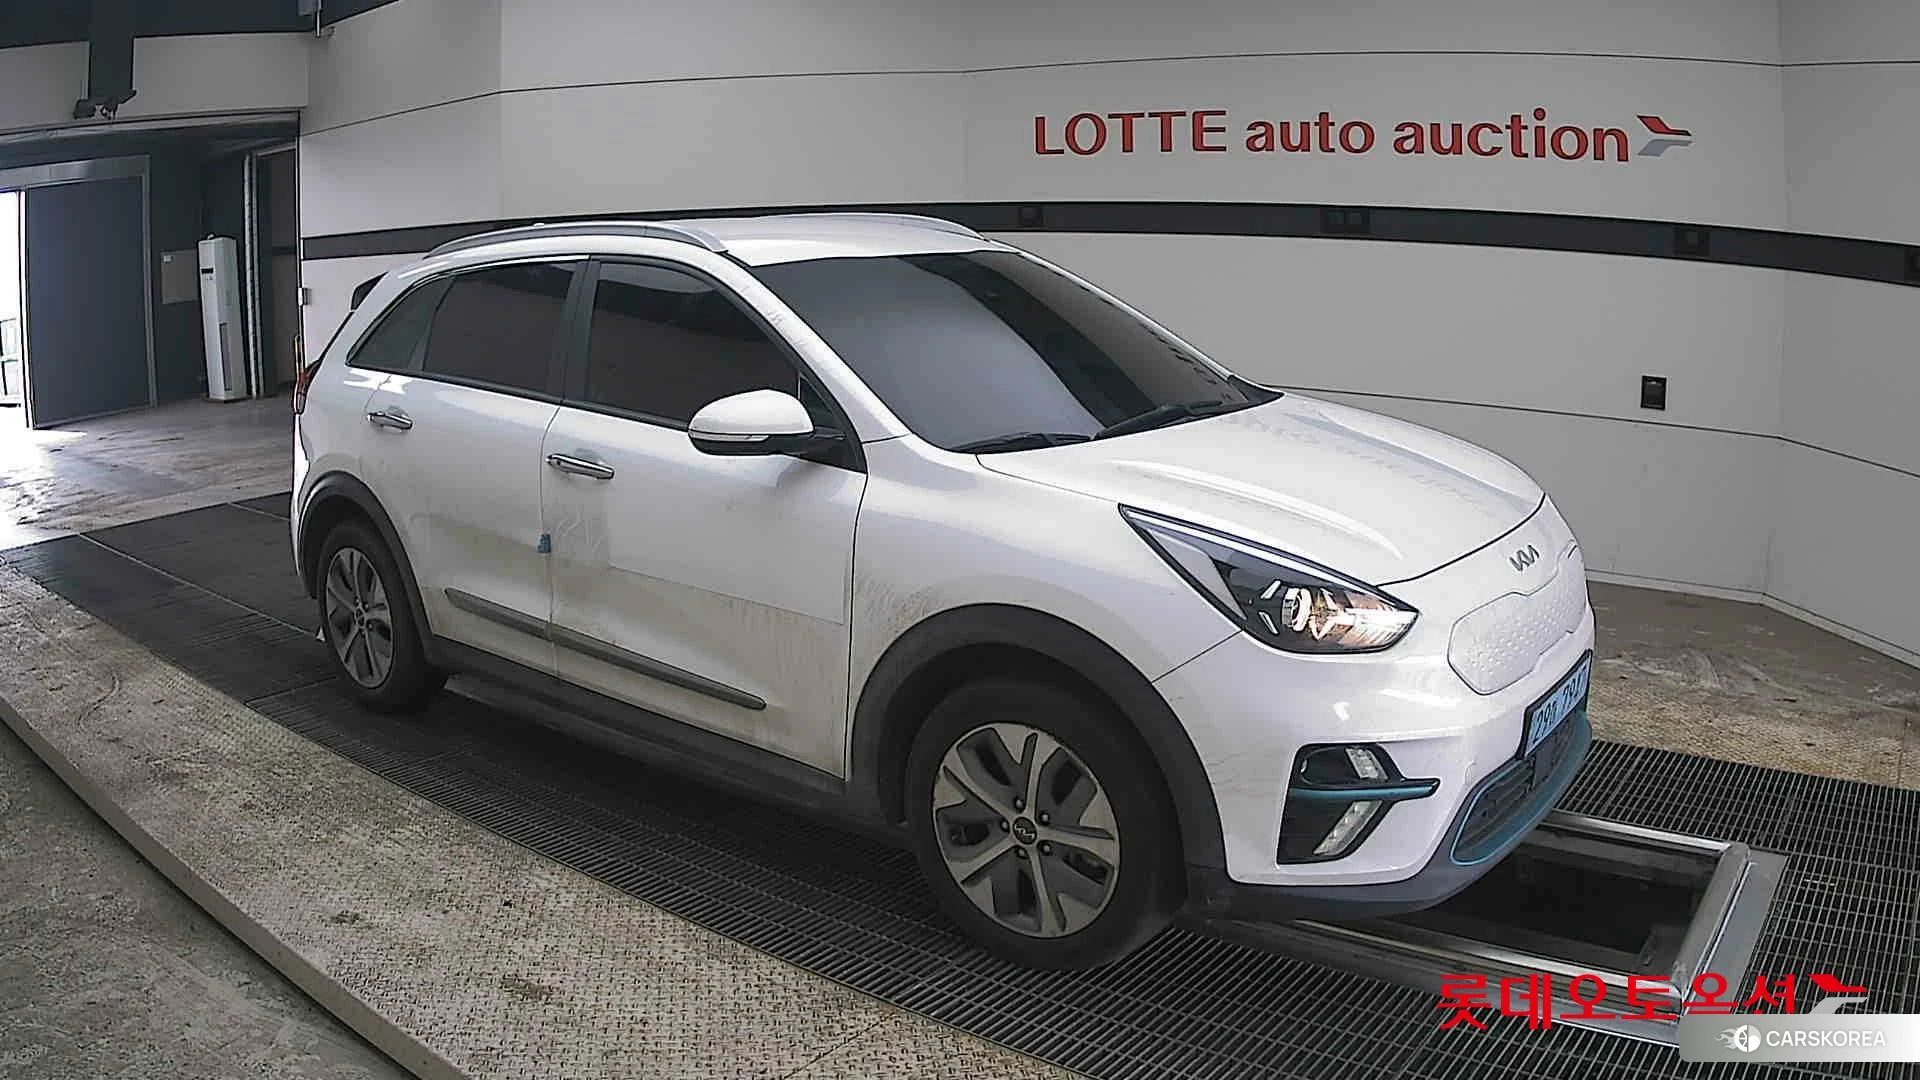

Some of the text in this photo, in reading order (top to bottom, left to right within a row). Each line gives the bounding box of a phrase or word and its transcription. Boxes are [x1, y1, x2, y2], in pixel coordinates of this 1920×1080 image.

[1035, 108, 1630, 163] LOTTE auto auction
